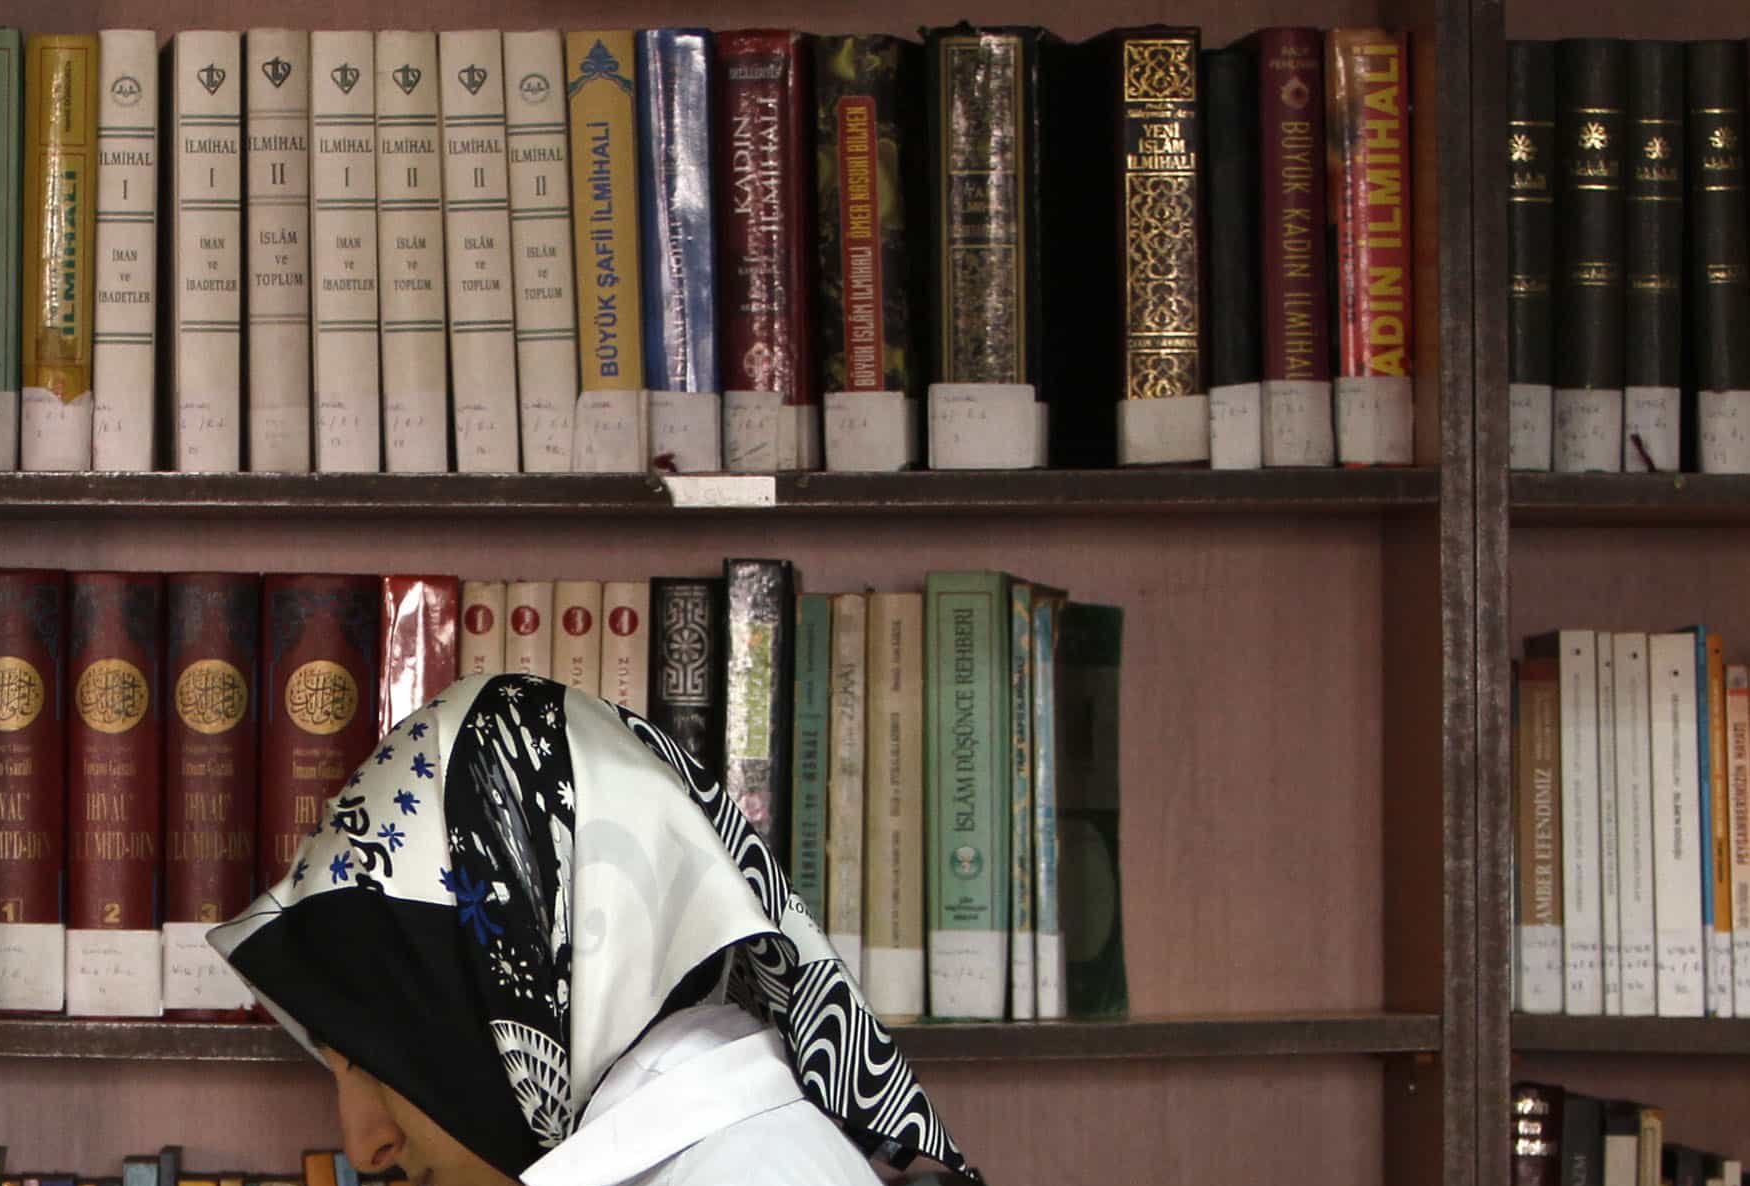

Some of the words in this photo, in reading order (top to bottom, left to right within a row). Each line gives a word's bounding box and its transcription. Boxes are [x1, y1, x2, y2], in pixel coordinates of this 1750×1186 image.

[185, 136, 239, 155] İLMİHAL
[248, 134, 307, 152] İLMİHAL
[319, 136, 373, 154] İLMİHAL
[381, 136, 435, 154] İLMİHAL
[448, 136, 503, 154] İLMİHAL
[846, 105, 870, 152] BİLMEN
[1143, 121, 1181, 139] YENİ
[1354, 42, 1404, 250] İLMİHALİ
[99, 149, 154, 167] İLMİHAL
[511, 145, 564, 163] İLMİHAL
[587, 121, 612, 222] İLMİHALİ
[732, 114, 753, 217] KADIN
[1127, 152, 1196, 170] İLMİHALİ
[847, 204, 872, 239] ÖMER
[590, 226, 620, 289] ŞAFİİ
[1281, 208, 1311, 279] KADIN
[594, 296, 619, 378] BÜYÜK
[1283, 291, 1315, 380] İLMİHAL
[1369, 265, 1405, 377] ADIN
[953, 607, 975, 685] REHBERİ
[953, 686, 979, 765] DÜŞÜNCE
[1534, 766, 1554, 861] EFENDİMİZ
[1, 902, 15, 924] 1
[104, 902, 122, 924] 2
[201, 902, 218, 924] 3
[1534, 863, 1554, 928] AMBER
